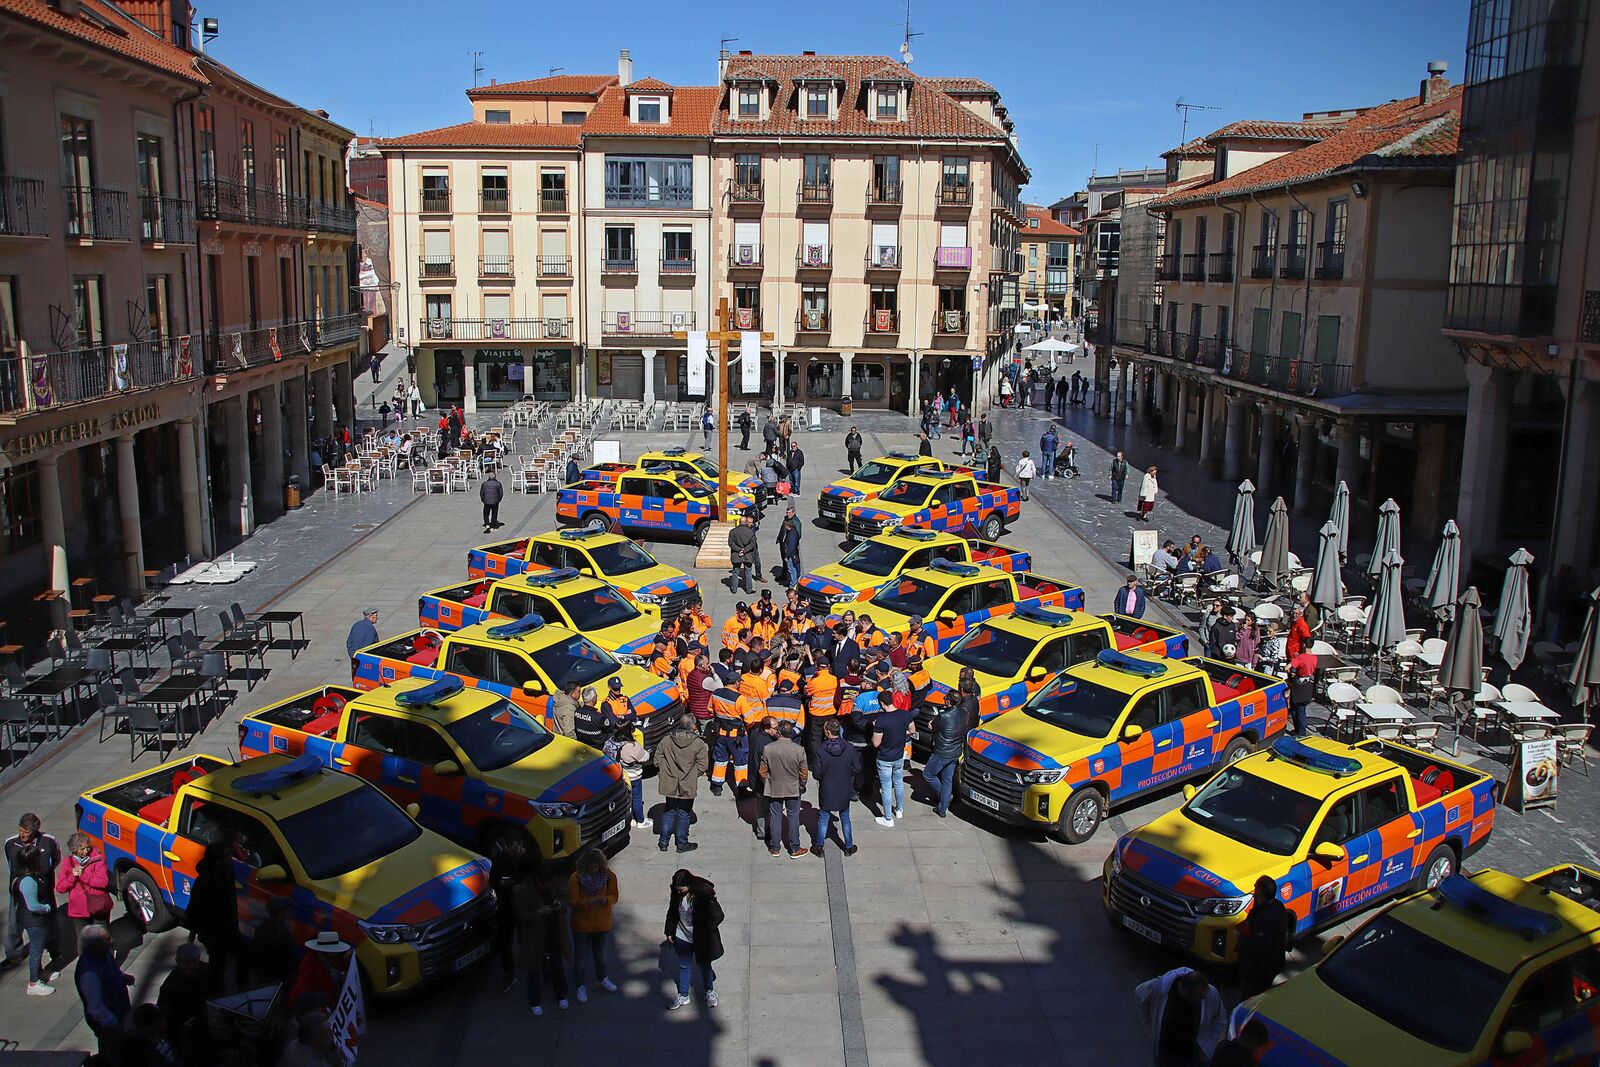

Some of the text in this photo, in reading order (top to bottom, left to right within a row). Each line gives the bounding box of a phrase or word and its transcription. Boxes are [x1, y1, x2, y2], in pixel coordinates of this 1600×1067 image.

[483, 350, 511, 358] VIAJES
[114, 402, 161, 431] ASADOR
[1137, 763, 1193, 789] PROTECCIÓN CIVIL
[454, 864, 479, 878] CIVIL
[1194, 869, 1223, 886] CIVIL
[1372, 881, 1389, 895] CIVIL
